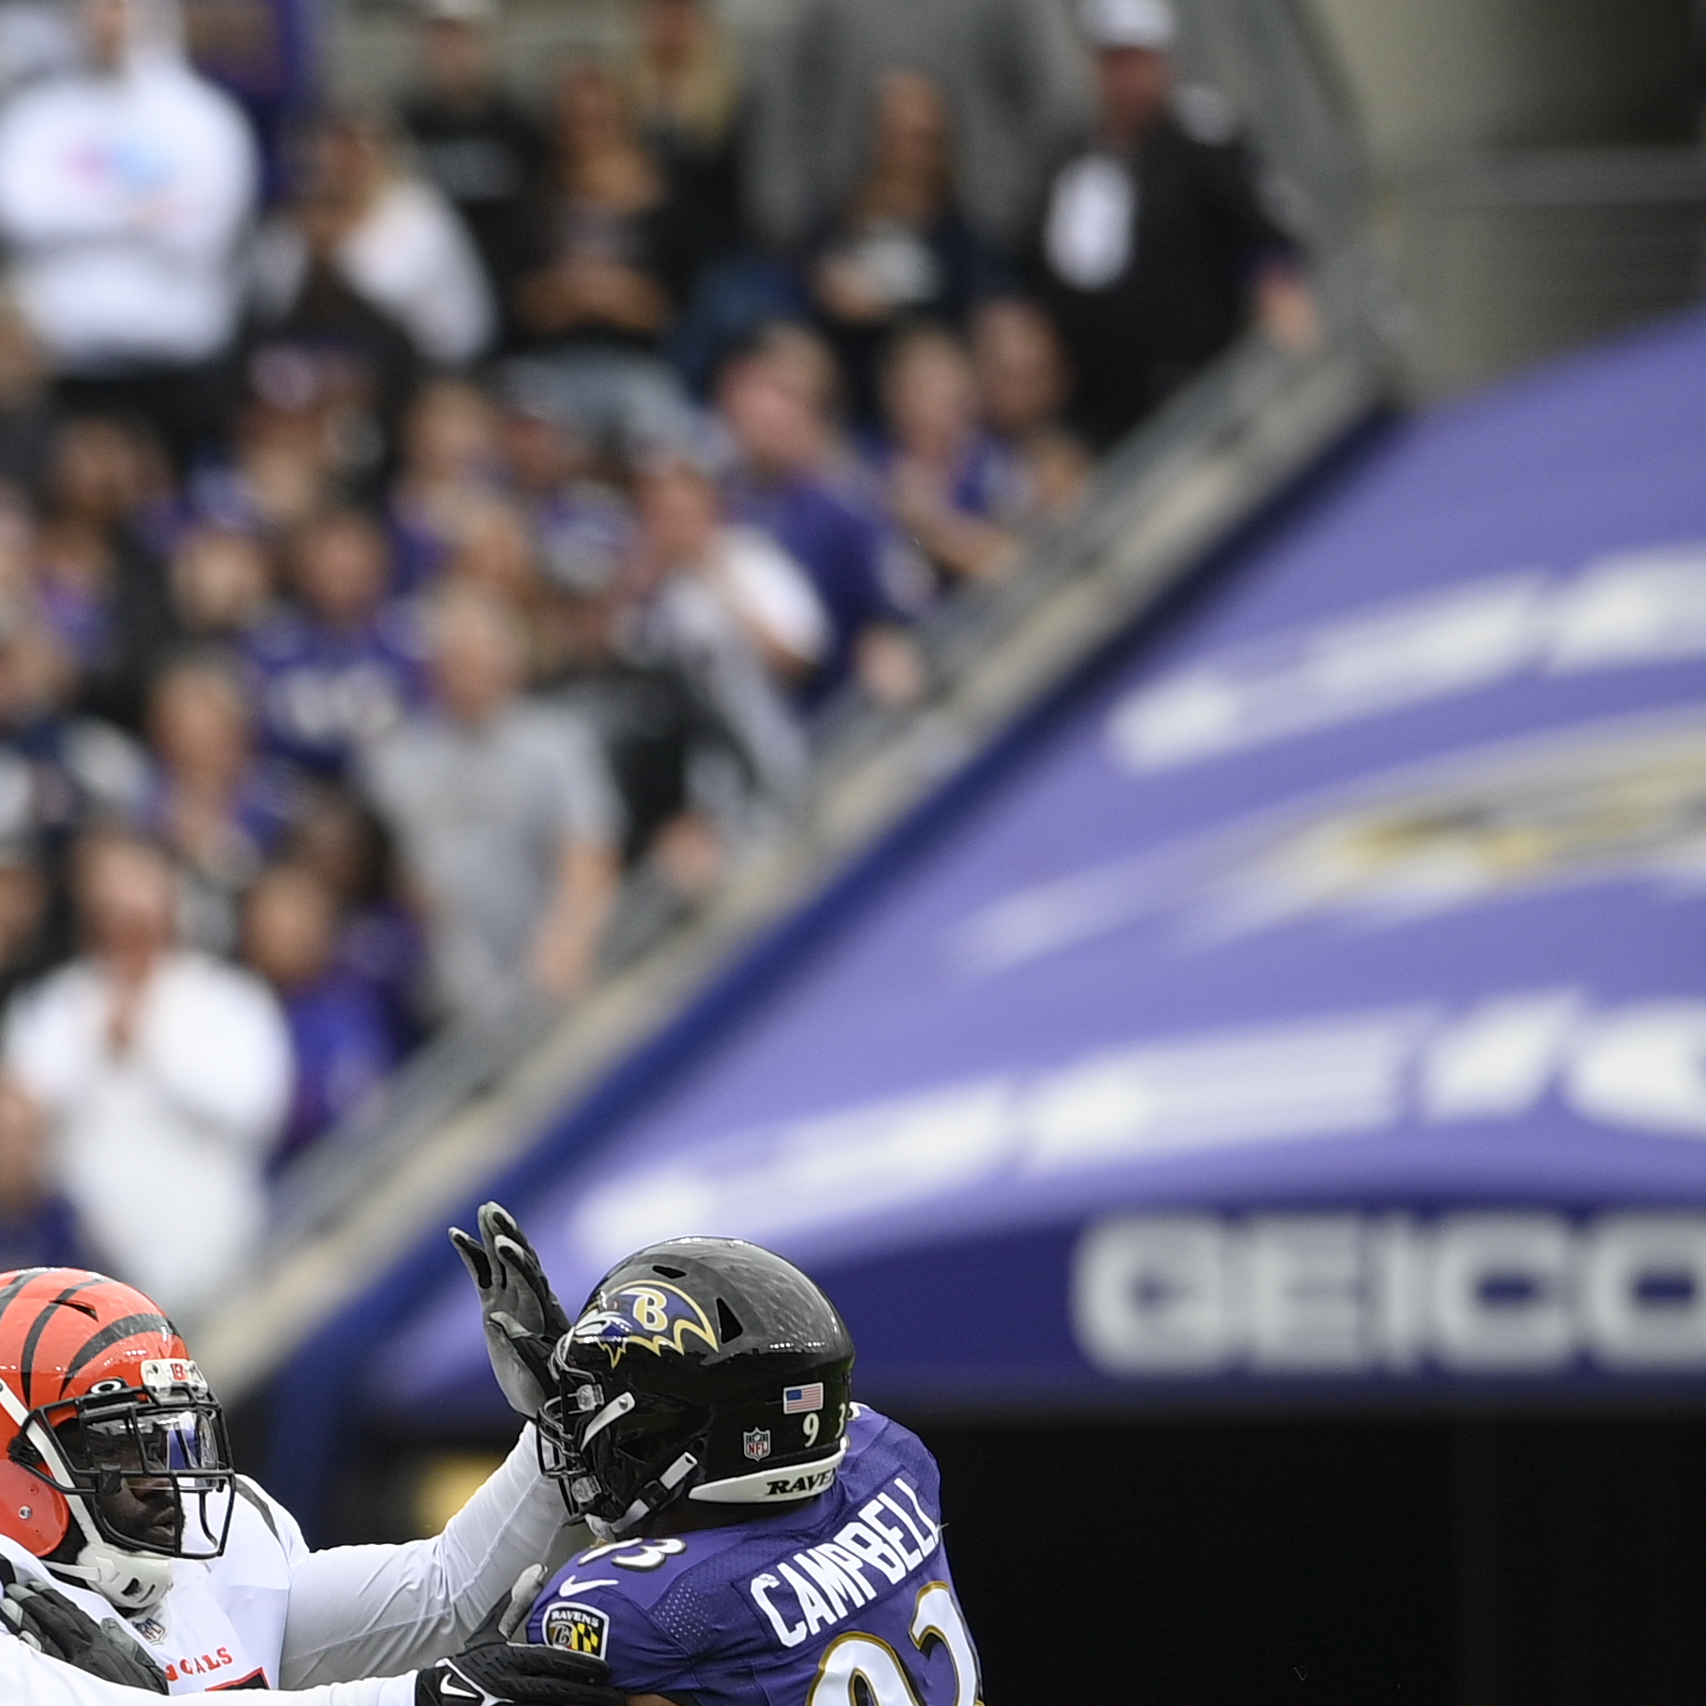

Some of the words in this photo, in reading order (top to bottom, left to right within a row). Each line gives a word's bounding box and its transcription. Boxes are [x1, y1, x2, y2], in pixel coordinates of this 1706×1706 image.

[1076, 1212, 1706, 1372] GEICO
[765, 1467, 837, 1496] RAVE
[751, 1478, 942, 1648] CAMPBELL
[551, 1610, 599, 1629] RAVENS
